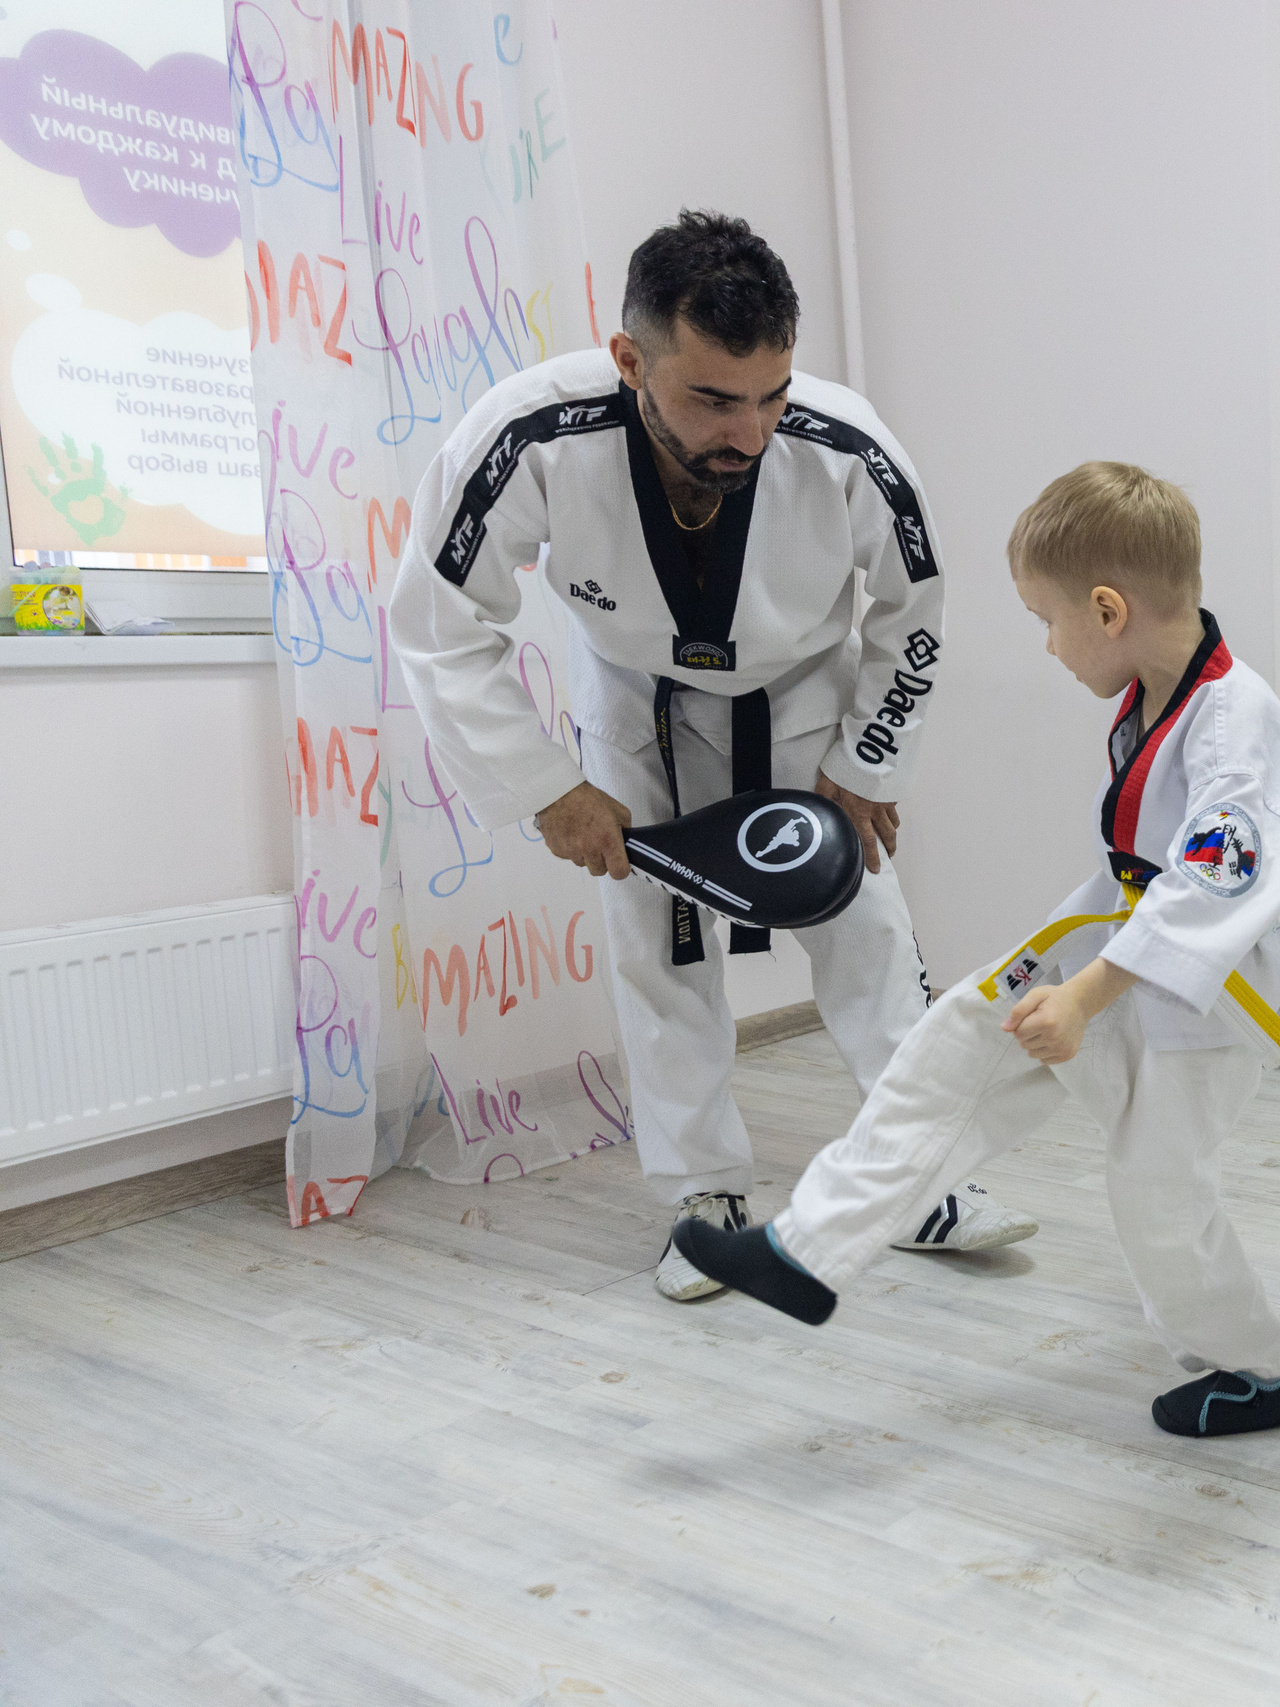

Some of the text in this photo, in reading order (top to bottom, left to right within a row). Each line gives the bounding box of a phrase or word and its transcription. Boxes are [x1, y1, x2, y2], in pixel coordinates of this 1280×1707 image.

[272, 400, 358, 499] ive
[558, 405, 607, 426] WTF
[450, 512, 474, 566] WTF
[901, 516, 925, 561] WTF
[569, 582, 617, 612] Daedo
[855, 668, 933, 766] Daedo
[669, 860, 695, 880] KHAN
[301, 869, 377, 959] ive
[412, 905, 593, 1037] MAZING
[430, 1052, 538, 1146] Live
